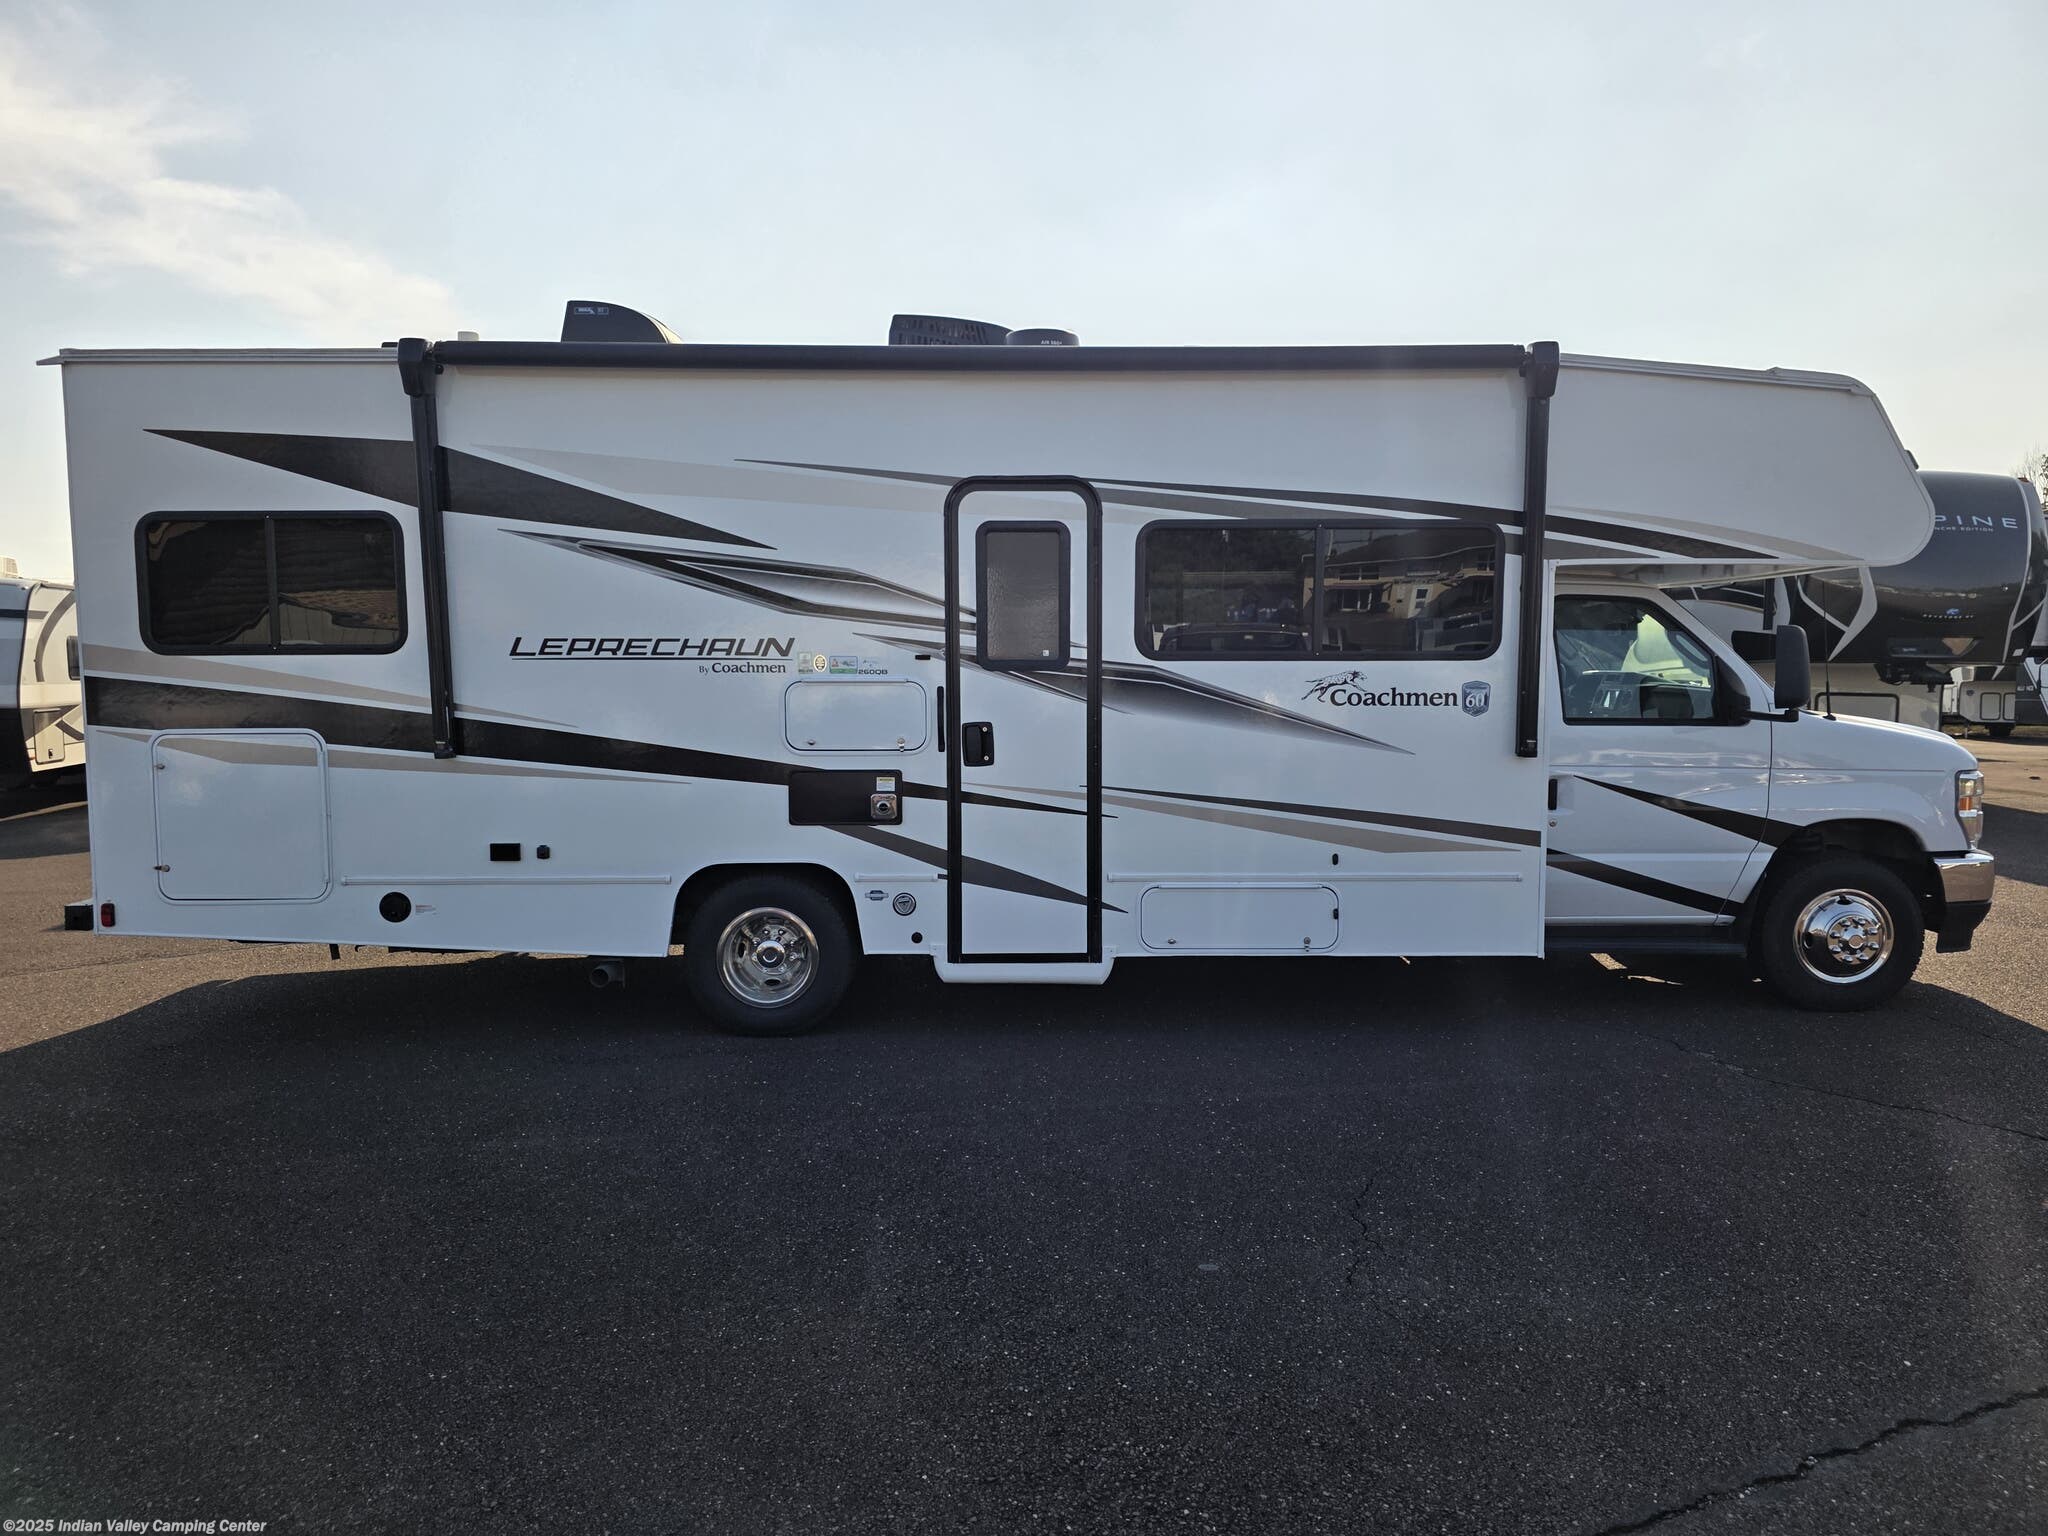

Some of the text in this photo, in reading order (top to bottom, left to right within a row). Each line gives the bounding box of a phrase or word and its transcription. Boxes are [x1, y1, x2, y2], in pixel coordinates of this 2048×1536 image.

[509, 636, 796, 657] LEPRECHAUN
[698, 661, 786, 674] By Coachmen
[1329, 686, 1485, 708] Coachmen 60
